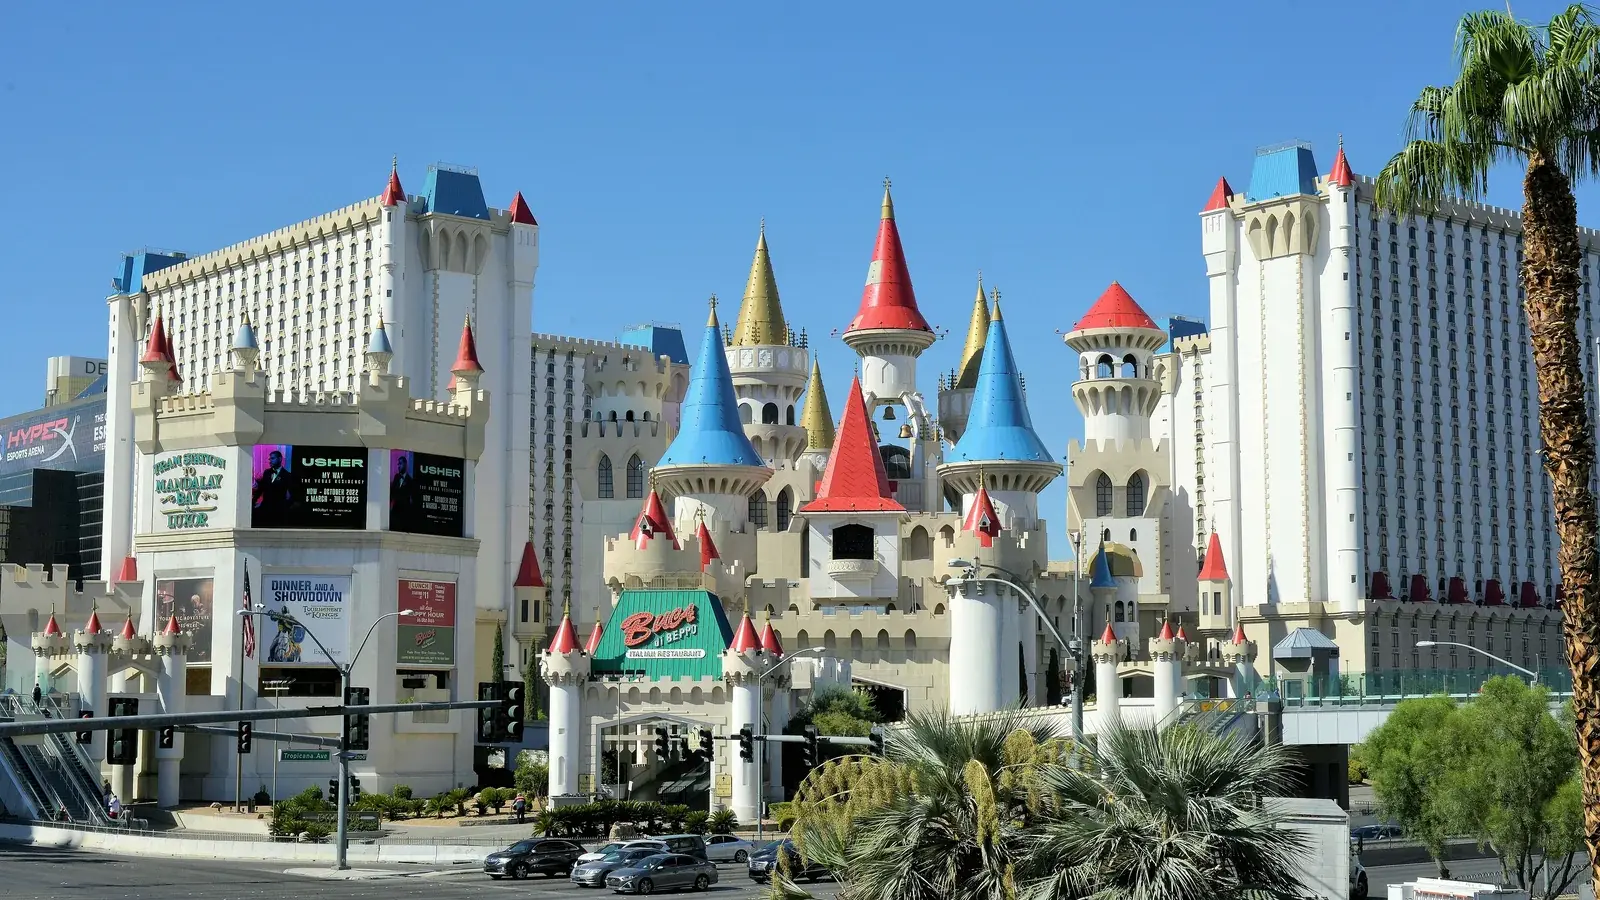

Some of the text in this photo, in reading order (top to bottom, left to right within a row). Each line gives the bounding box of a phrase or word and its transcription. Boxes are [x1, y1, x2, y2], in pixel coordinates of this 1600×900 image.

[7, 445, 45, 461] ESPORTS ARENA
[153, 453, 226, 476] TRAM STATION
[302, 457, 364, 468] USHER
[182, 466, 197, 477] TO
[322, 471, 330, 479] MY
[420, 465, 461, 478] USHER
[155, 474, 224, 493] MANDALAY
[323, 488, 345, 496] OCTOBER
[346, 488, 359, 496] 2022
[176, 490, 201, 506] BAY
[167, 512, 209, 529] LUXOR
[271, 580, 335, 592] DINNER AND A
[274, 591, 342, 602] SHOWDOWN
[311, 611, 339, 619] KINGS
[666, 624, 698, 643] BEPPO
[629, 650, 702, 658] ITALIAN RESTAURANT
[284, 752, 328, 760] Tropicana Ave
